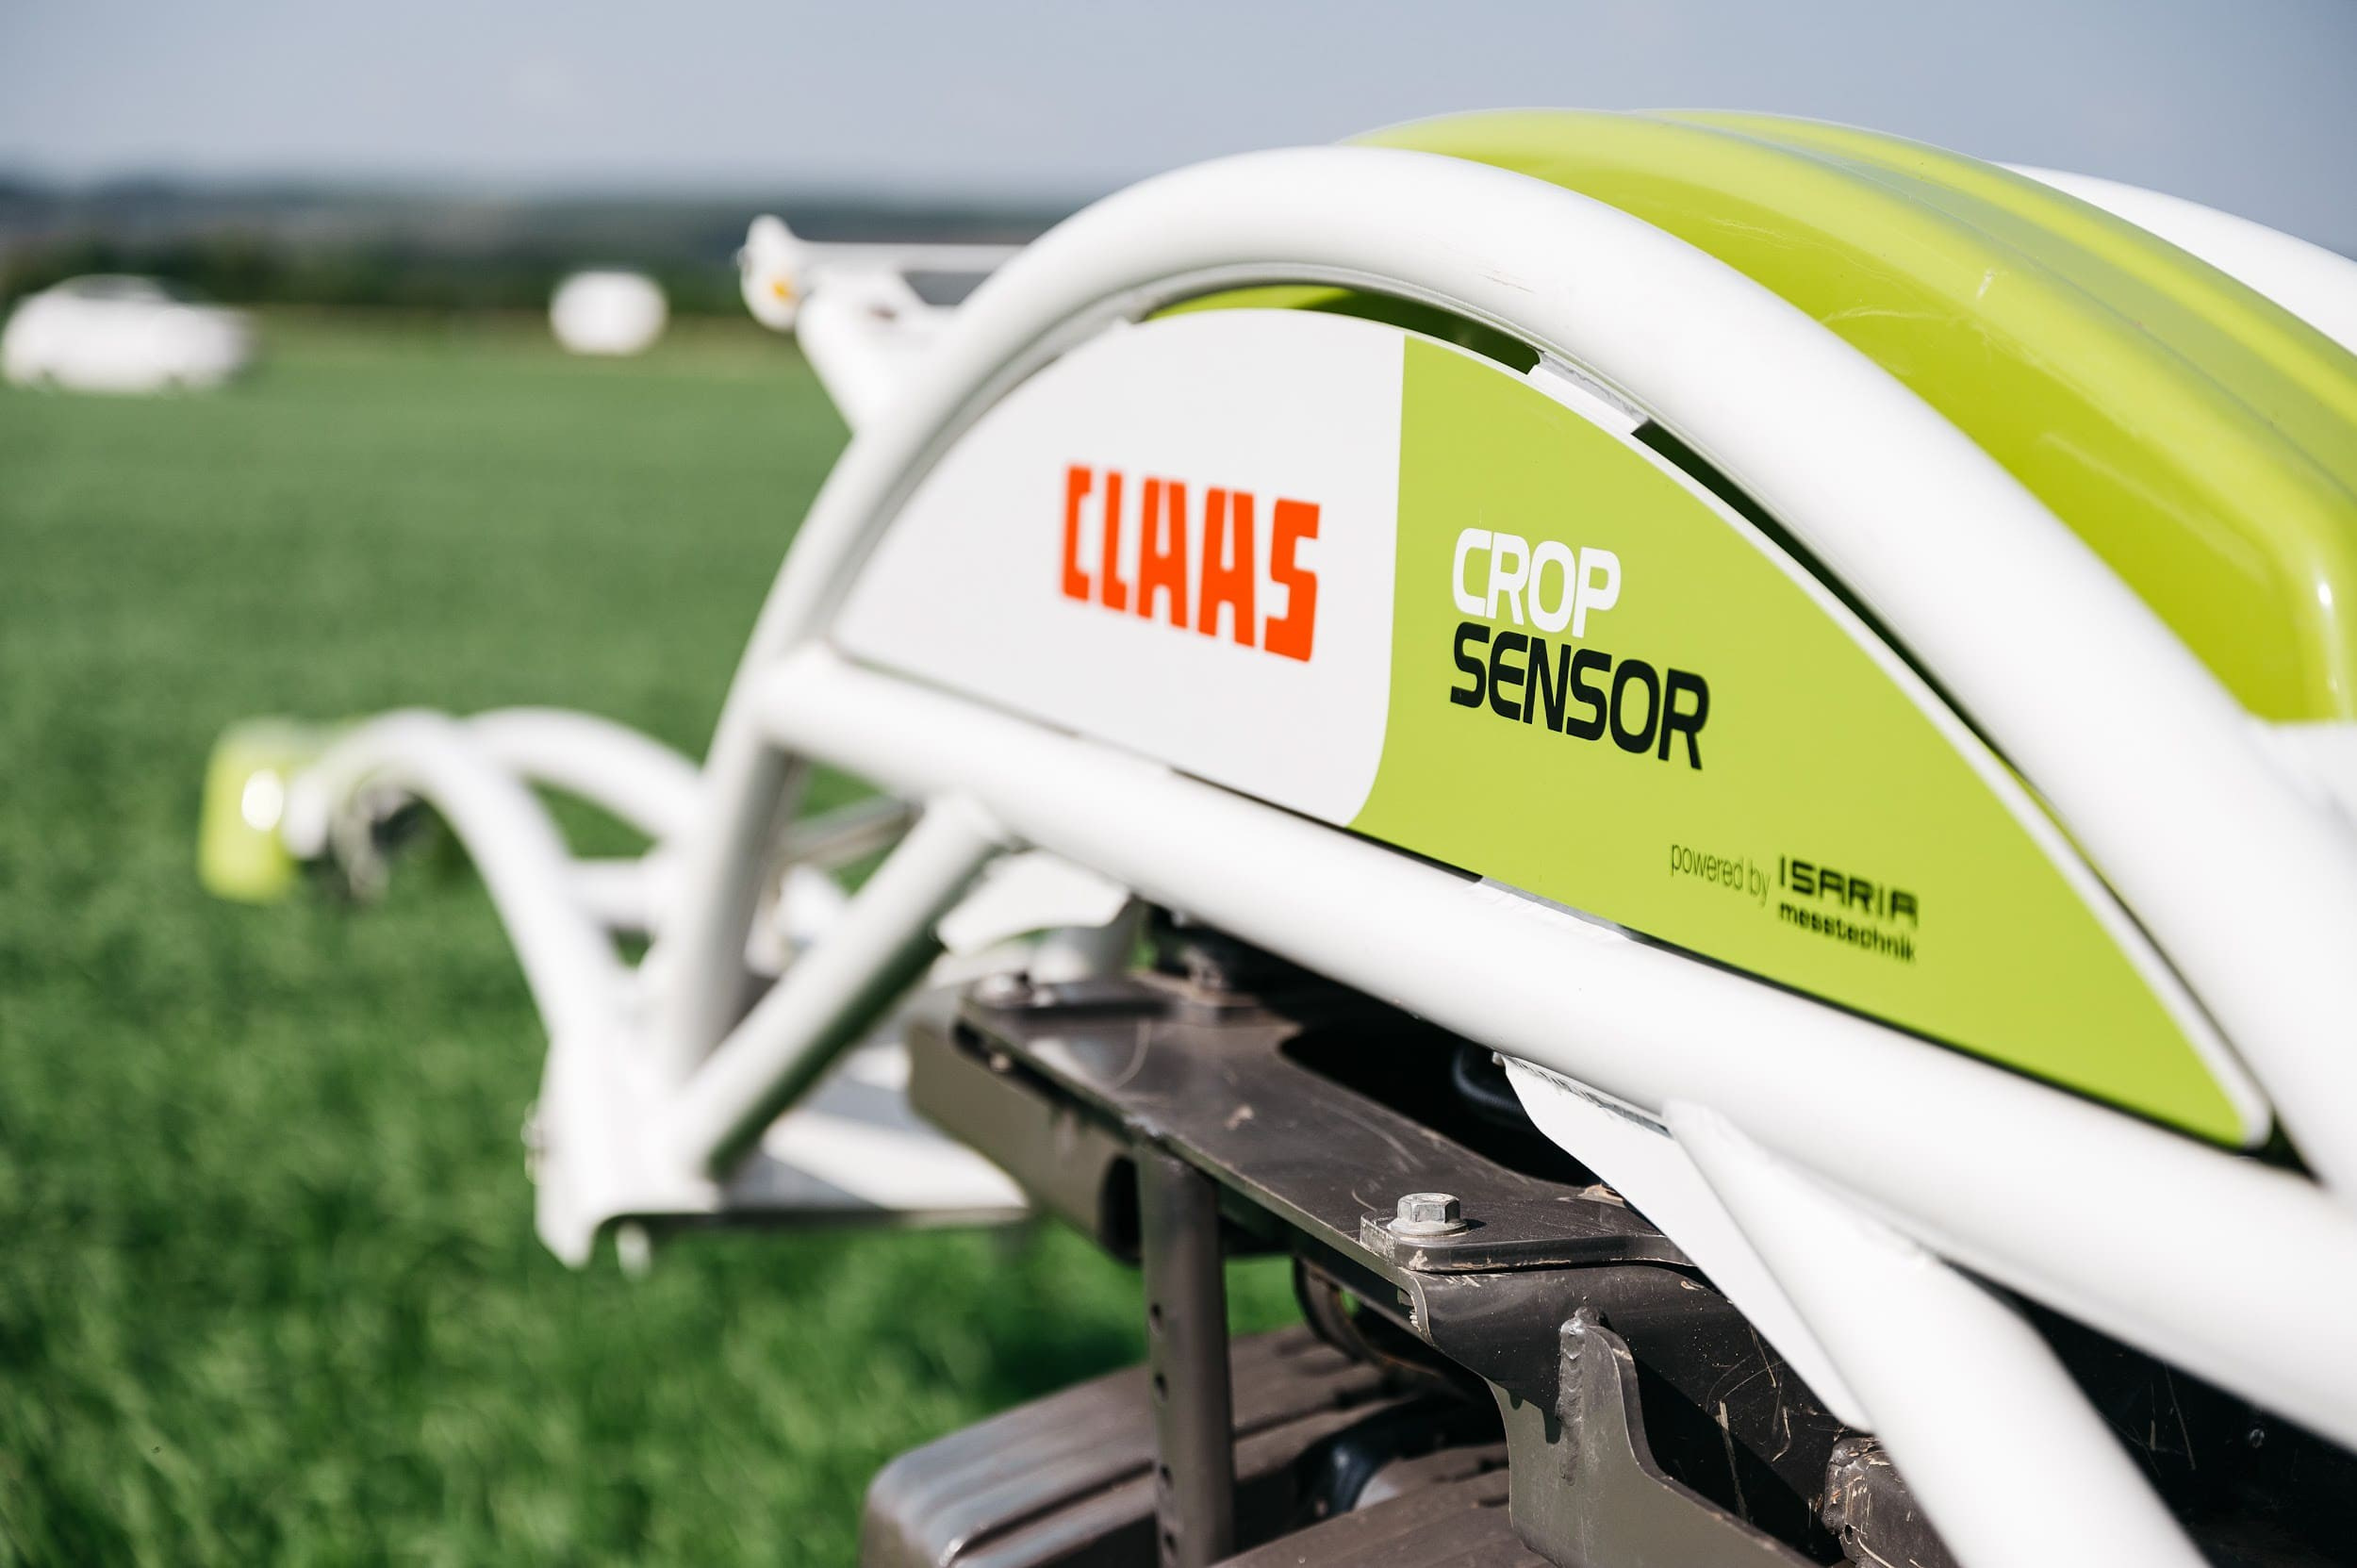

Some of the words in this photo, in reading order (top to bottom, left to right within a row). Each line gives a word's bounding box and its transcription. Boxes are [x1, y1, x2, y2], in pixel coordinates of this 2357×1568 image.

[1063, 465, 1321, 662] CLAAS
[1452, 526, 1622, 638] CROP
[1450, 620, 1710, 770] SENSOR
[1671, 844, 1744, 891] powered
[1749, 859, 1772, 906] by
[1779, 854, 1919, 929] ISARIA
[1779, 901, 1916, 963] messtechnik
